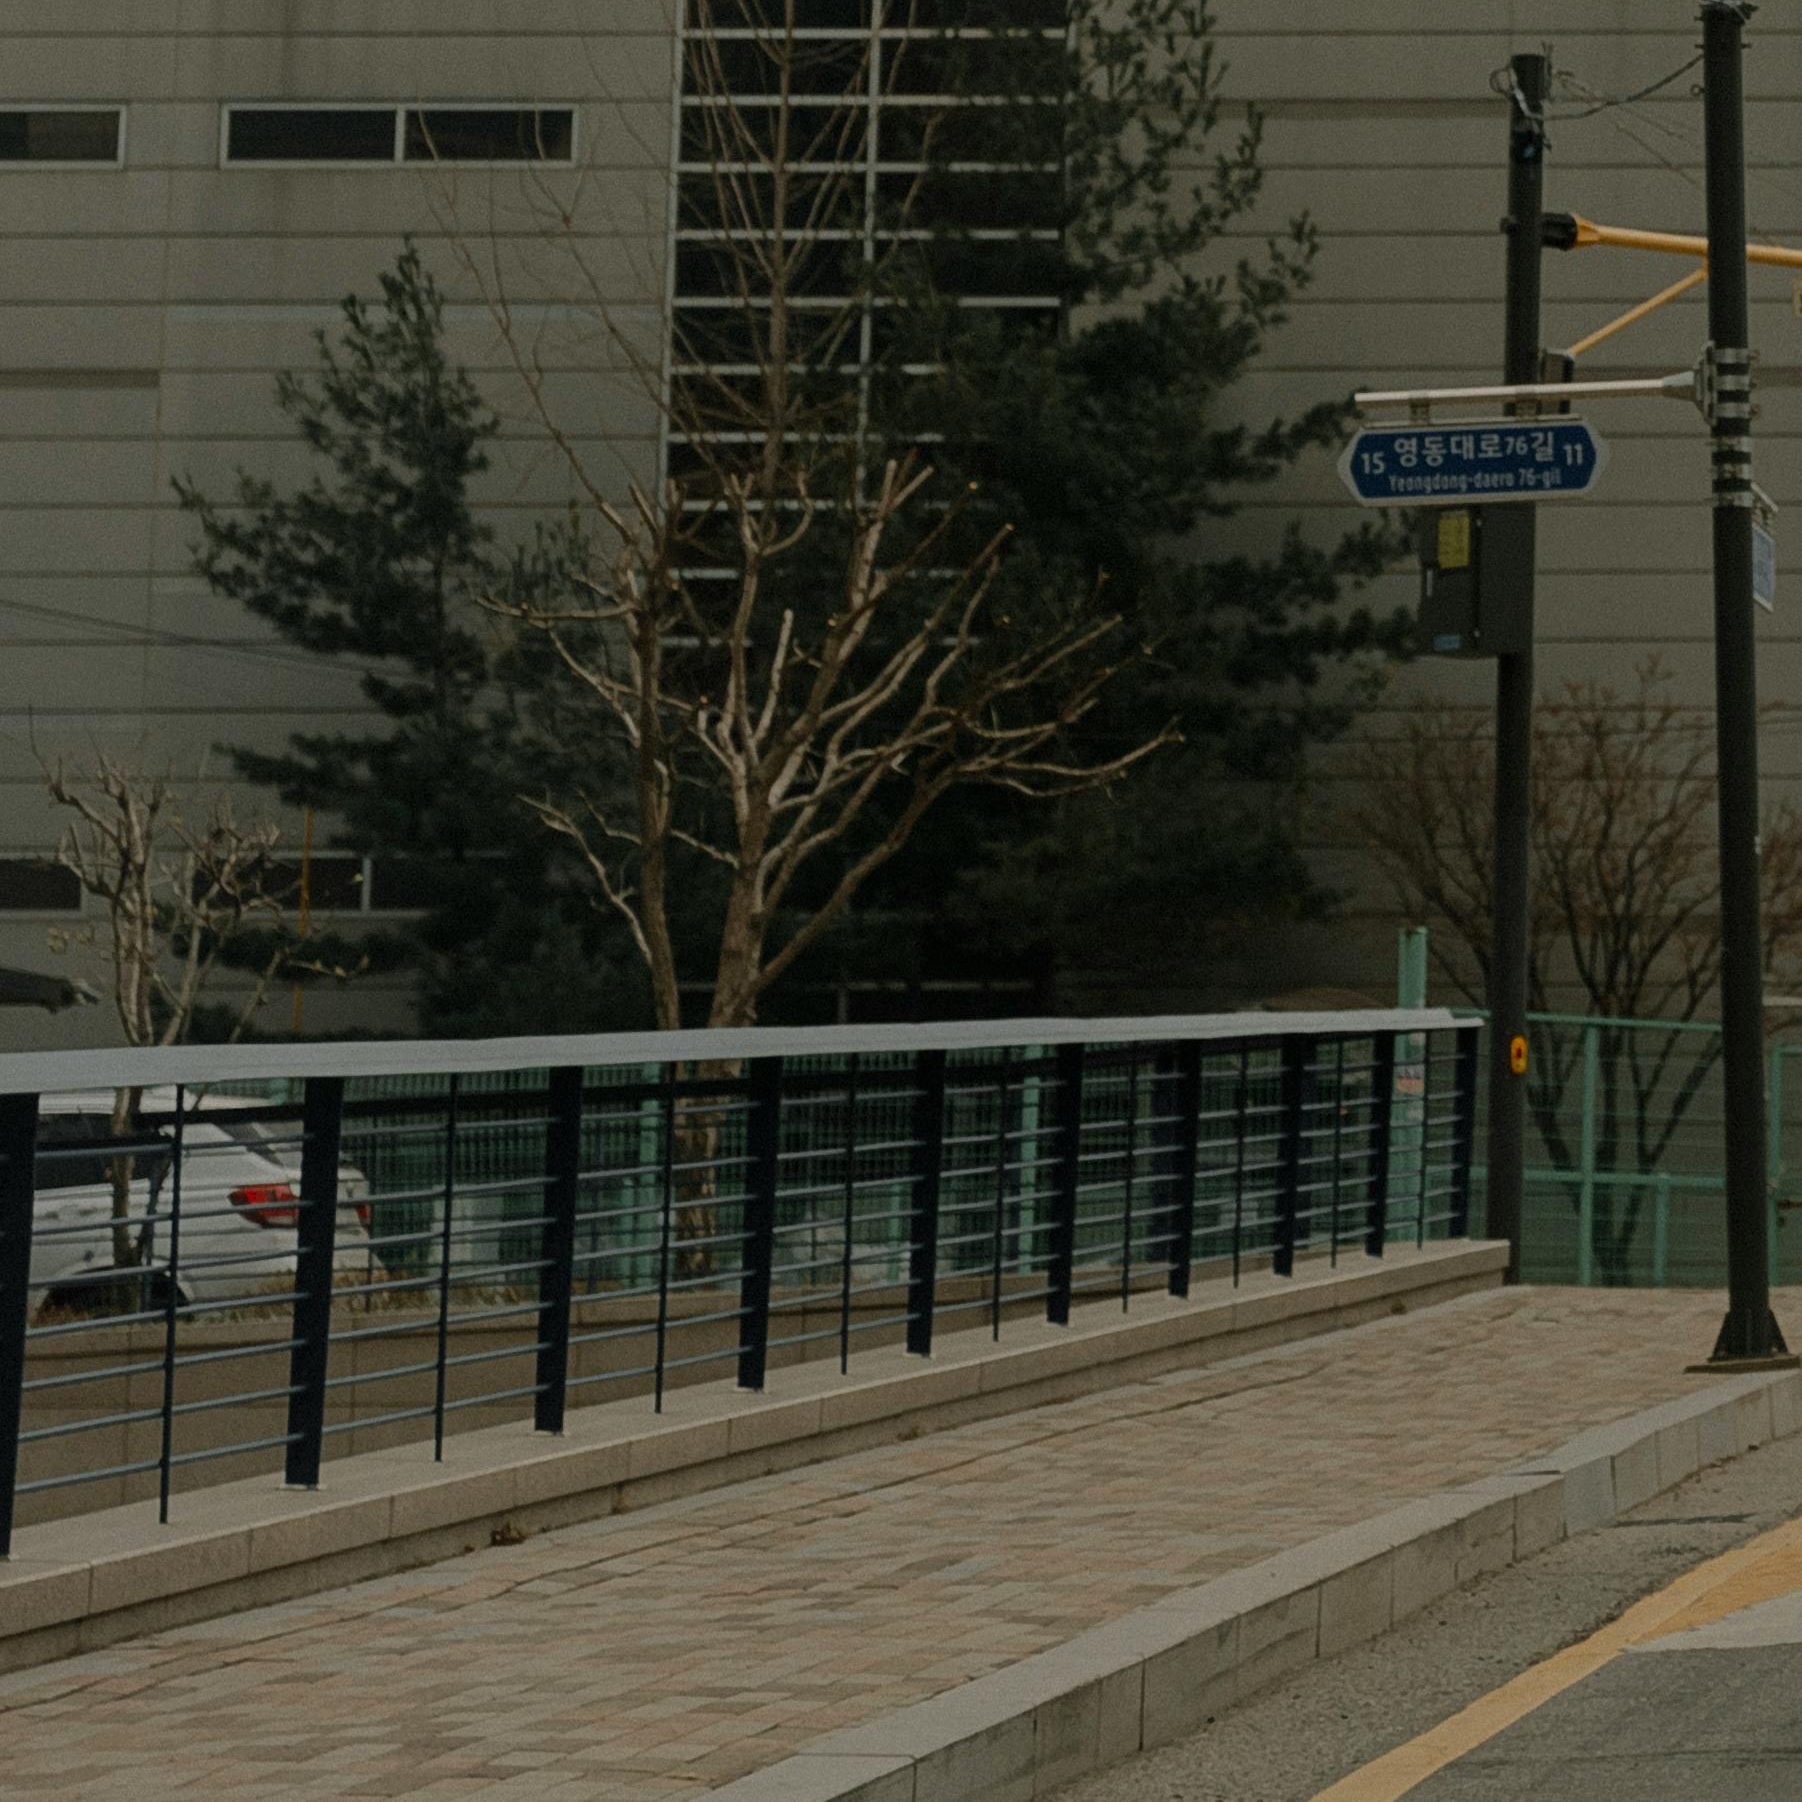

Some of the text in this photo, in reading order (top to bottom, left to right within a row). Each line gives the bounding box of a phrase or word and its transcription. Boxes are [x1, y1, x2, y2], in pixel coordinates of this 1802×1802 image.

[1361, 430, 1584, 475] 15 영동대로76길 11
[1388, 467, 1562, 494] Yeongdong-daero 76-gil
